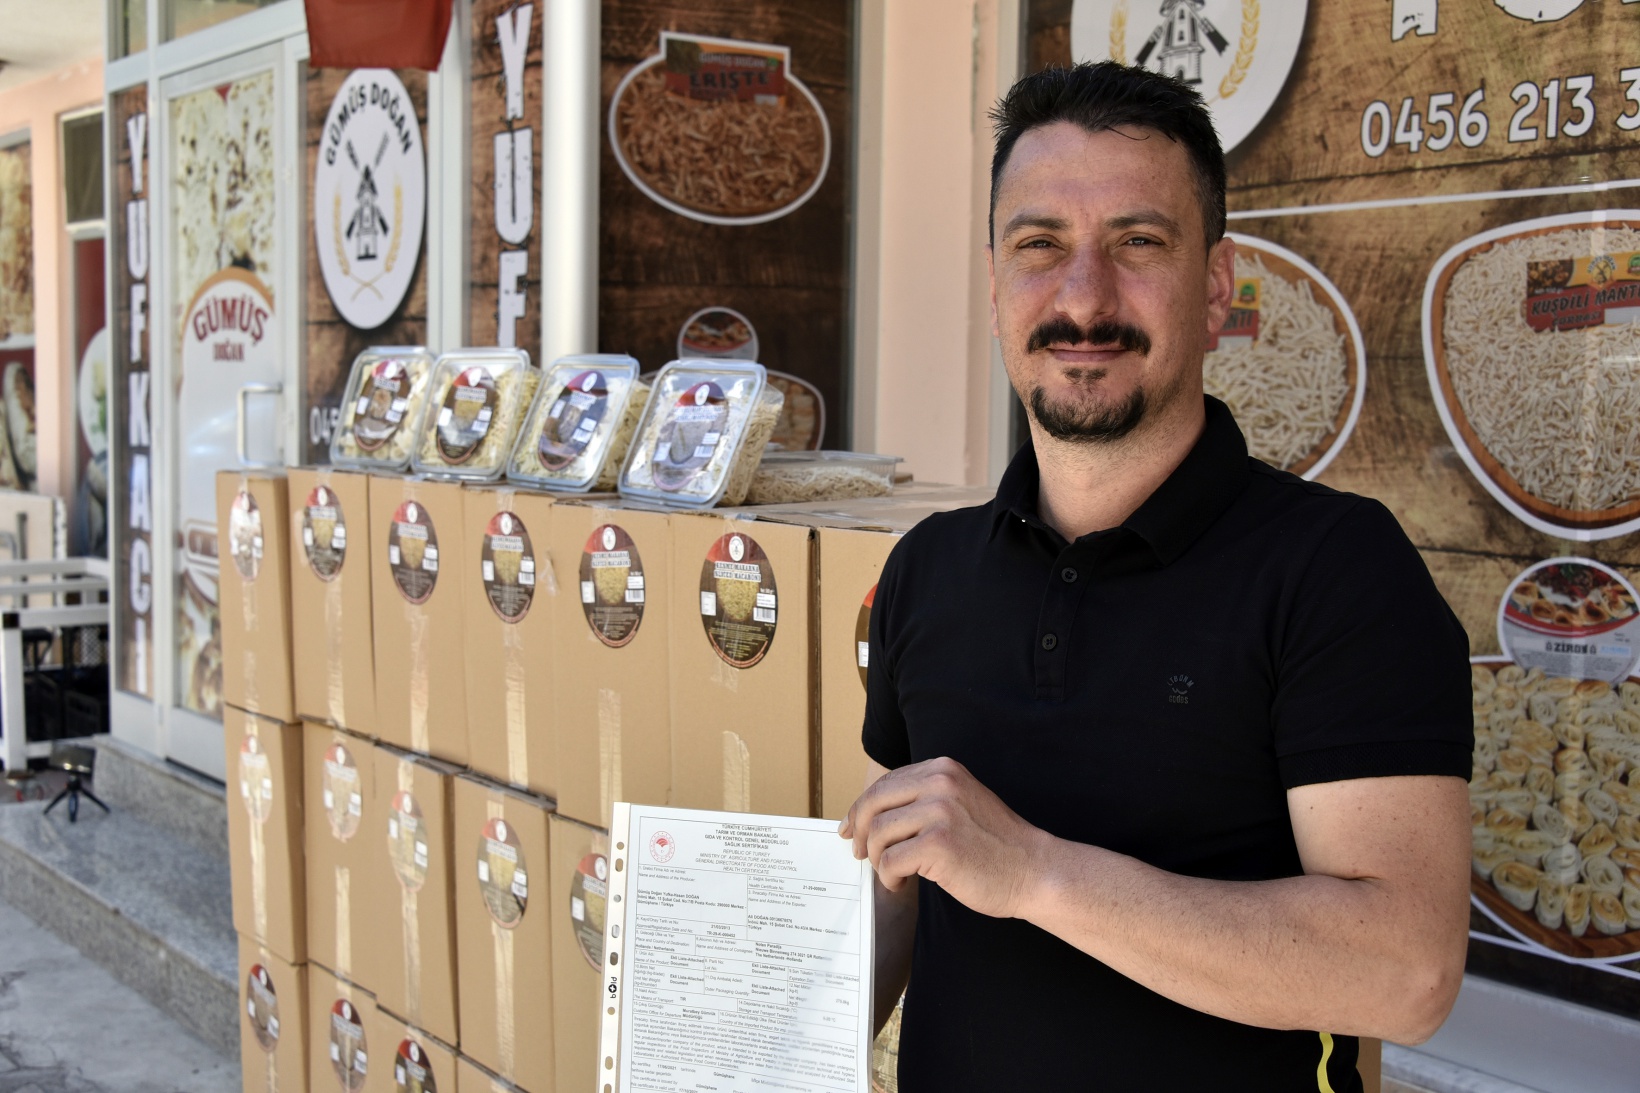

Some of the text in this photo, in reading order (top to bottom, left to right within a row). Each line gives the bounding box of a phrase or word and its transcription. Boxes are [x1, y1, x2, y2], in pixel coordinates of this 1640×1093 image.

[326, 82, 413, 166] GÜMÜŞ DOĞAN
[1361, 88, 1489, 158] 0456
[1508, 74, 1596, 143] 213
[193, 294, 269, 347] GÜMÜŞ
